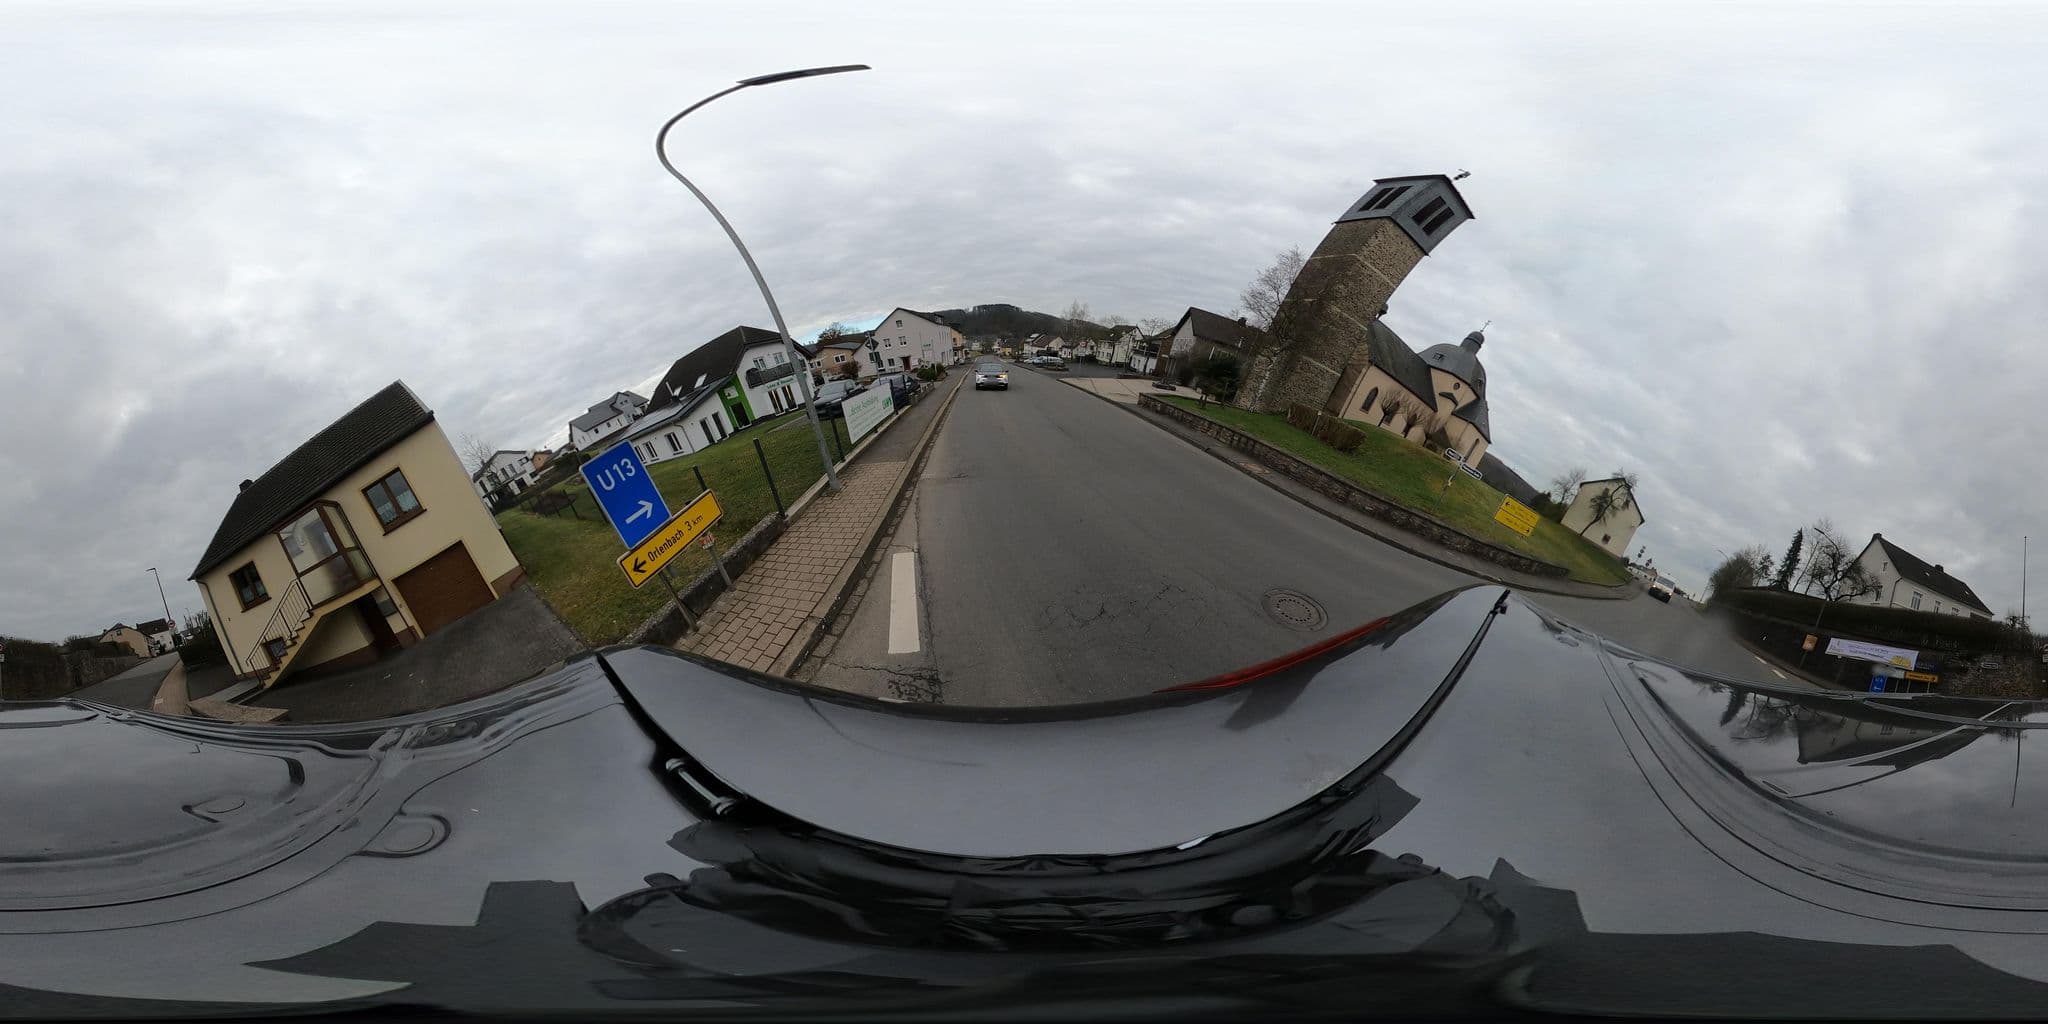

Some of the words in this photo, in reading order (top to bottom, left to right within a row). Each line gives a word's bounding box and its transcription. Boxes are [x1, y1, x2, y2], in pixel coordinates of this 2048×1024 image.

[647, 528, 685, 562] Orlenbach
[684, 521, 693, 531] 3
[693, 514, 704, 525] km
